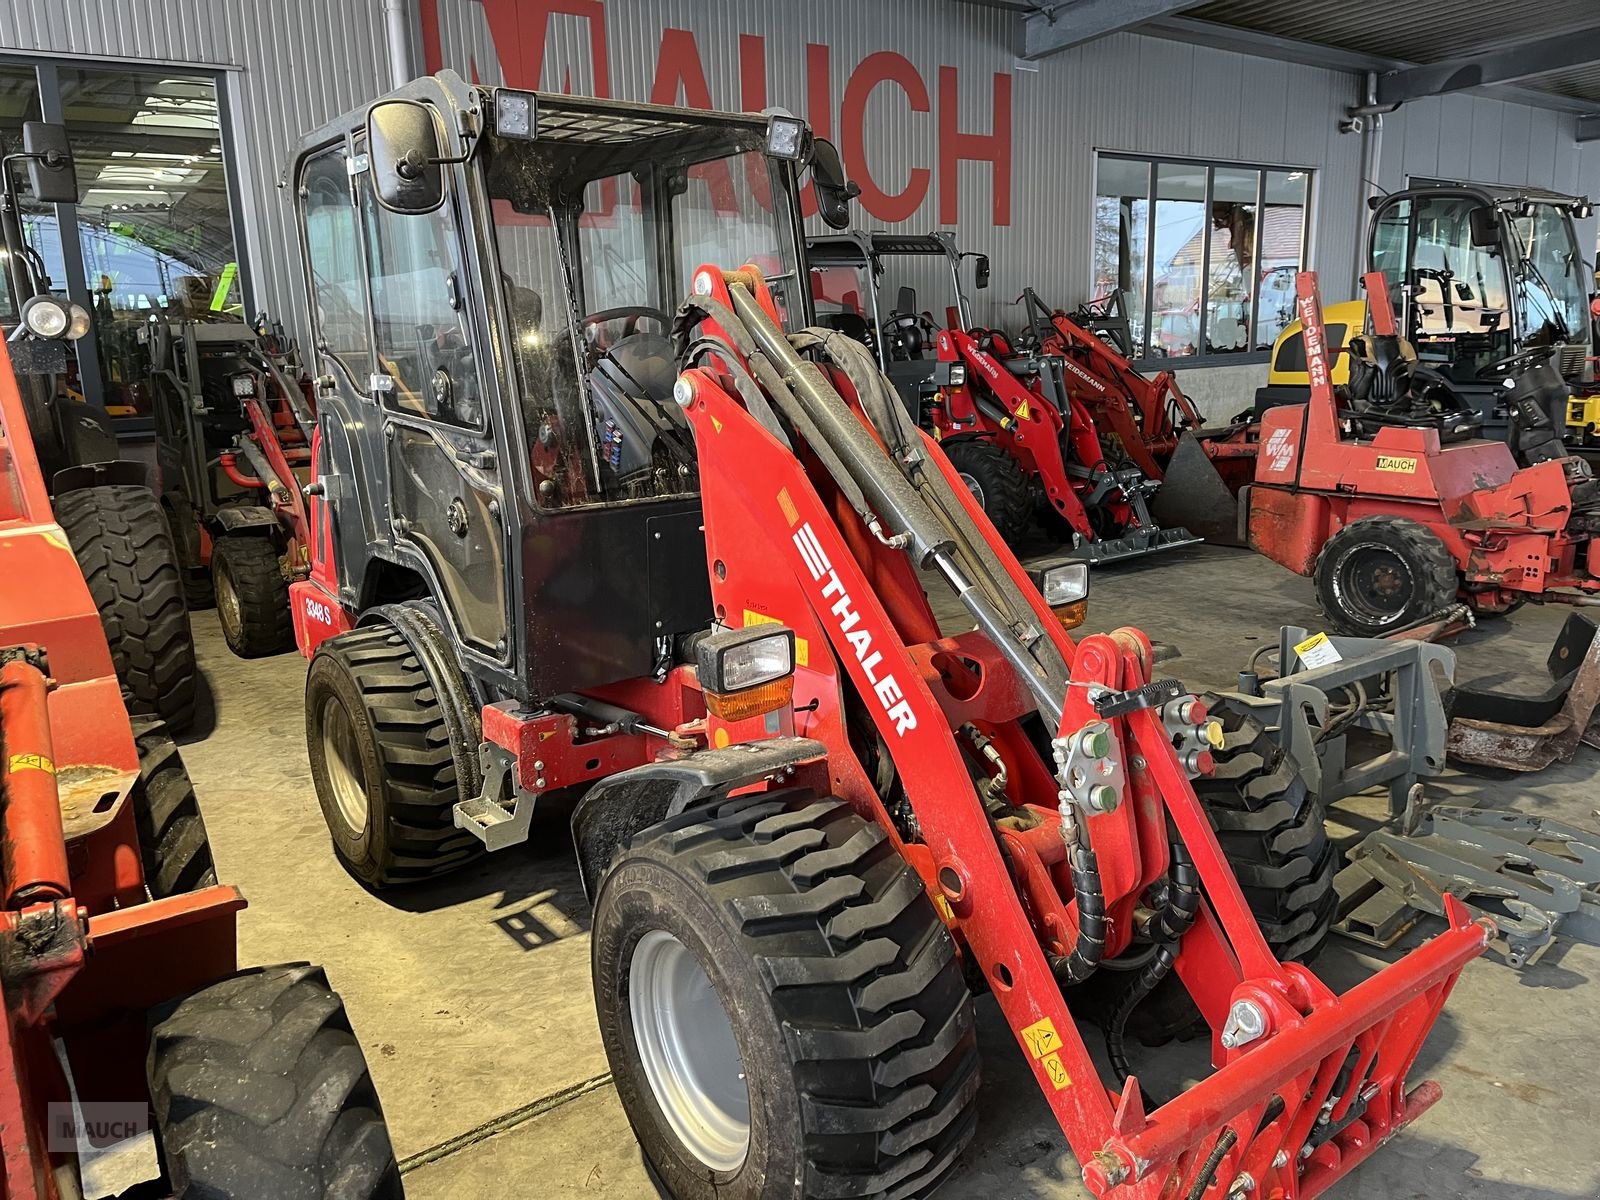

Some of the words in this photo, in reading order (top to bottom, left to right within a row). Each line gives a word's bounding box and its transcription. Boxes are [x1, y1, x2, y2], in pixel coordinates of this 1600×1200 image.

[420, 0, 1012, 227] MAUCH
[967, 343, 999, 379] WEIDEMANN
[1299, 296, 1325, 387] WEIDEMANN
[1378, 457, 1415, 470] MAUCH
